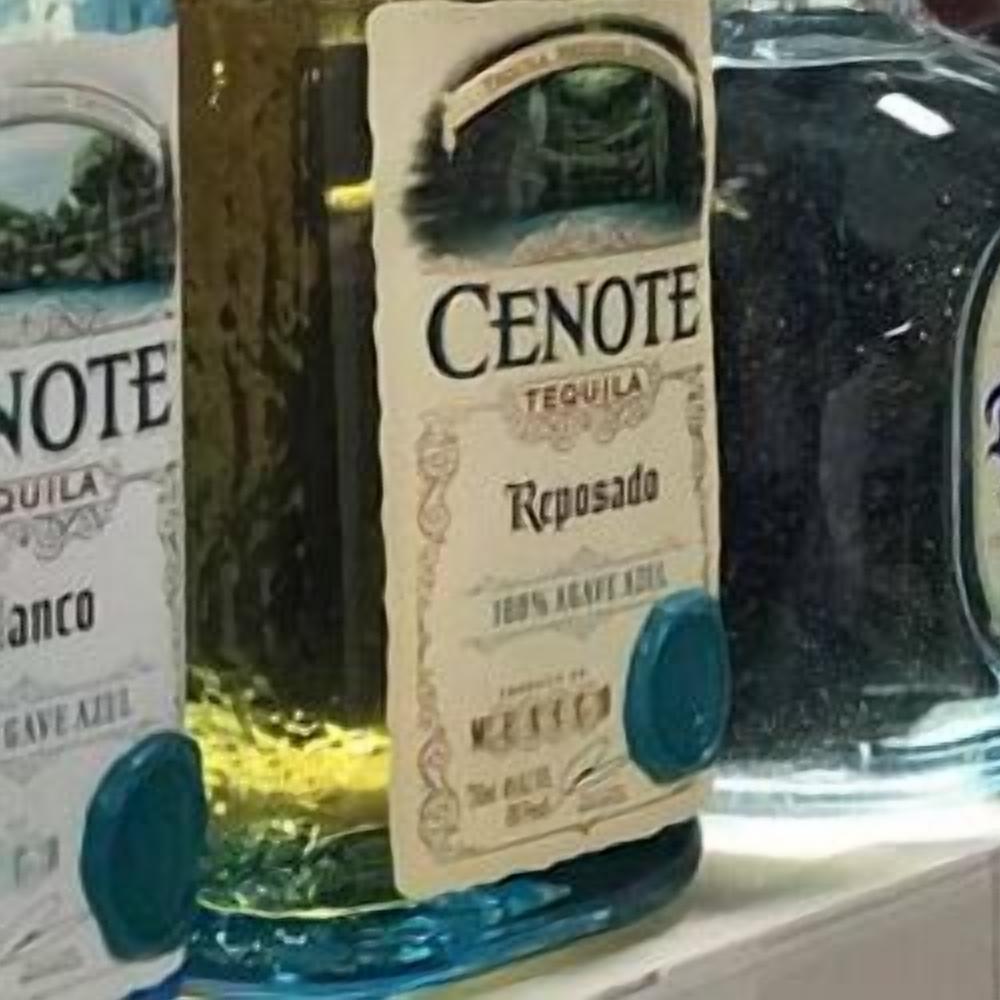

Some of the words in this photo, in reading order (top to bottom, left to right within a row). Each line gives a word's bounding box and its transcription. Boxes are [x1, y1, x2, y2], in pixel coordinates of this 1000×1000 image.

[425, 262, 700, 381] CENOTE
[524, 372, 643, 413] TEQUILA
[505, 461, 660, 534] Reposado
